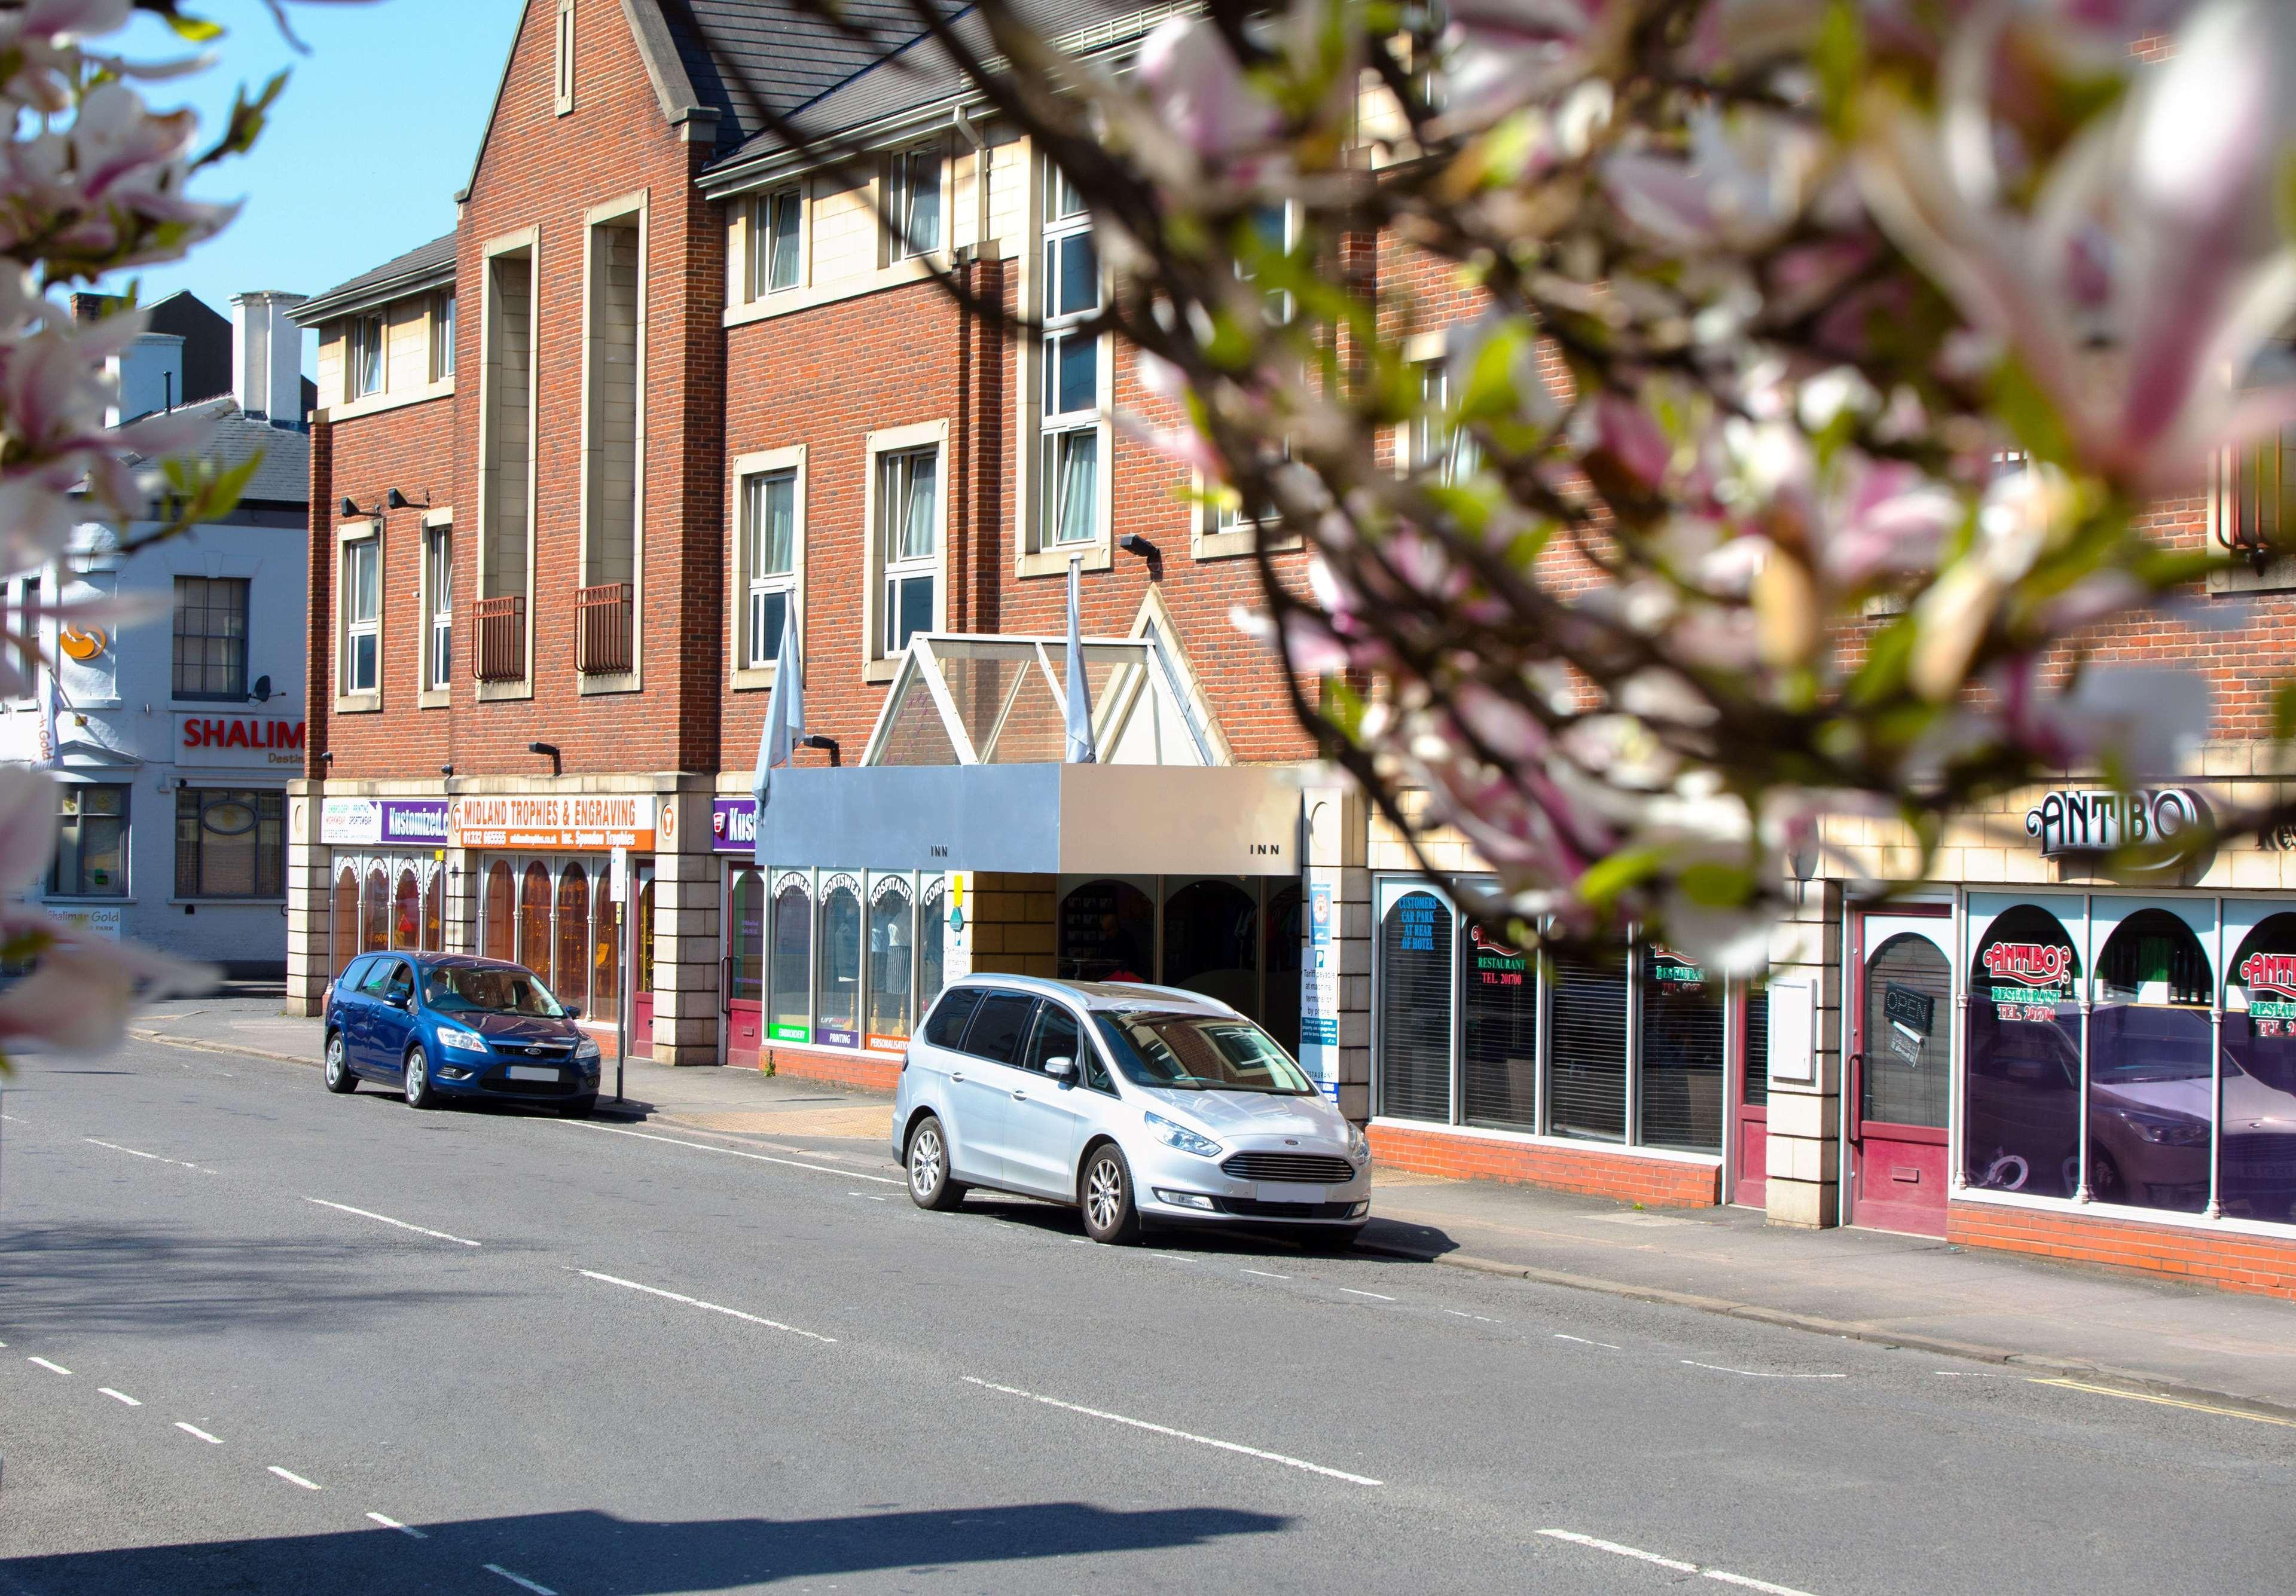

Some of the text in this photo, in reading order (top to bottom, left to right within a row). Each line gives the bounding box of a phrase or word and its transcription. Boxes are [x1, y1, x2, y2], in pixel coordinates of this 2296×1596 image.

[464, 799, 636, 826] MIDLAND TROPHIES & ENGRAVING
[463, 830, 482, 845] 01332
[605, 830, 636, 847] Trophies
[931, 845, 948, 857] INN
[1250, 844, 1279, 855] INN
[367, 858, 388, 879] PRINTING
[774, 873, 813, 900] WORKWEAR
[820, 875, 861, 906] SPORTSWEAR
[871, 877, 914, 907] HOSPITALITY
[1398, 897, 1437, 909] CUSTOMERS
[91, 911, 119, 922] Gold
[1402, 910, 1435, 923] CAR PARK
[1405, 925, 1432, 937] AT REAR
[1402, 937, 1434, 950] OF HOTEL
[1478, 958, 1526, 970] RESTAURANT
[1983, 942, 2067, 983] ANTIBO
[1304, 969, 1315, 977] Tariff
[1482, 973, 1522, 985] TEL. 201700
[1992, 986, 2062, 1004] RESTAURANT
[1308, 1007, 1314, 1016] by
[1887, 992, 1927, 1022] OPEN
[1998, 1004, 2022, 1021] TEL.
[778, 1028, 806, 1039] EMBROIDERY
[829, 1032, 851, 1044] PRINTING
